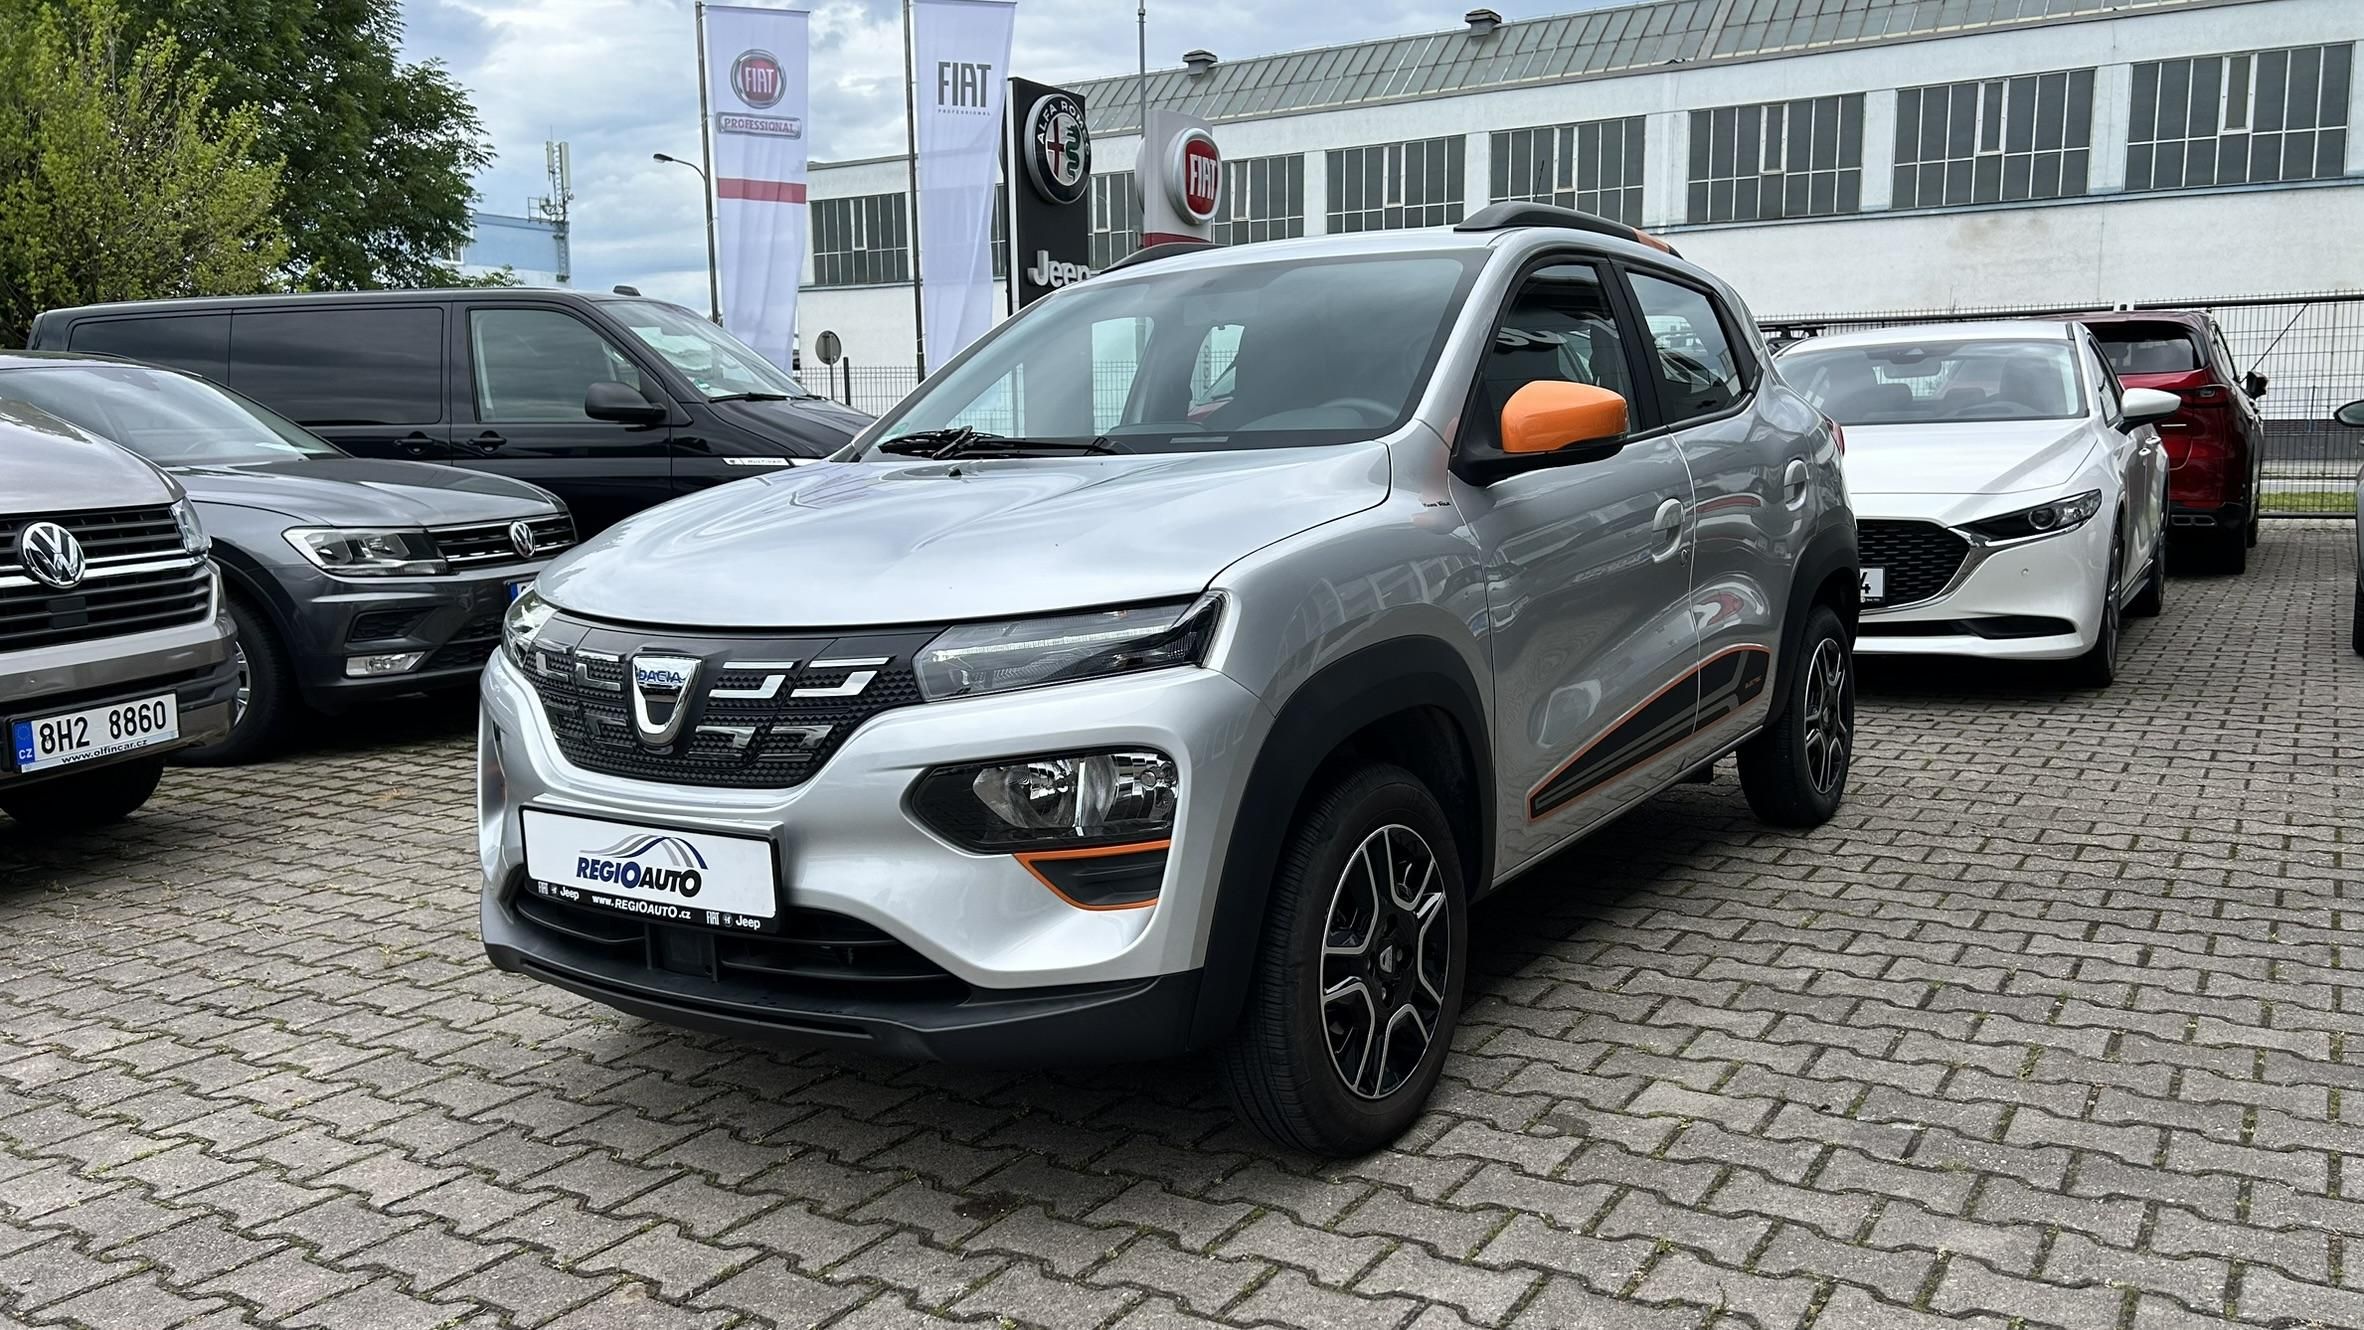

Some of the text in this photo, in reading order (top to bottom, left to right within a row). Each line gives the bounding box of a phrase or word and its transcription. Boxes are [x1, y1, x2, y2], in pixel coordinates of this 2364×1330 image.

[745, 67, 775, 94] FIAT
[938, 61, 992, 108] FIAT
[724, 117, 796, 133] PROFESSIONAL
[1037, 103, 1057, 145] ALFA
[1189, 153, 1217, 200] FIAT
[638, 669, 682, 683] DACIA
[39, 700, 167, 755] 8H2 8860
[18, 748, 33, 759] CZ
[61, 738, 148, 764] www.olfincar.cz
[576, 856, 702, 898] REGIOAUTO
[559, 886, 580, 901] Jeep
[706, 910, 720, 926] FIAT
[735, 915, 761, 931] Jeep
